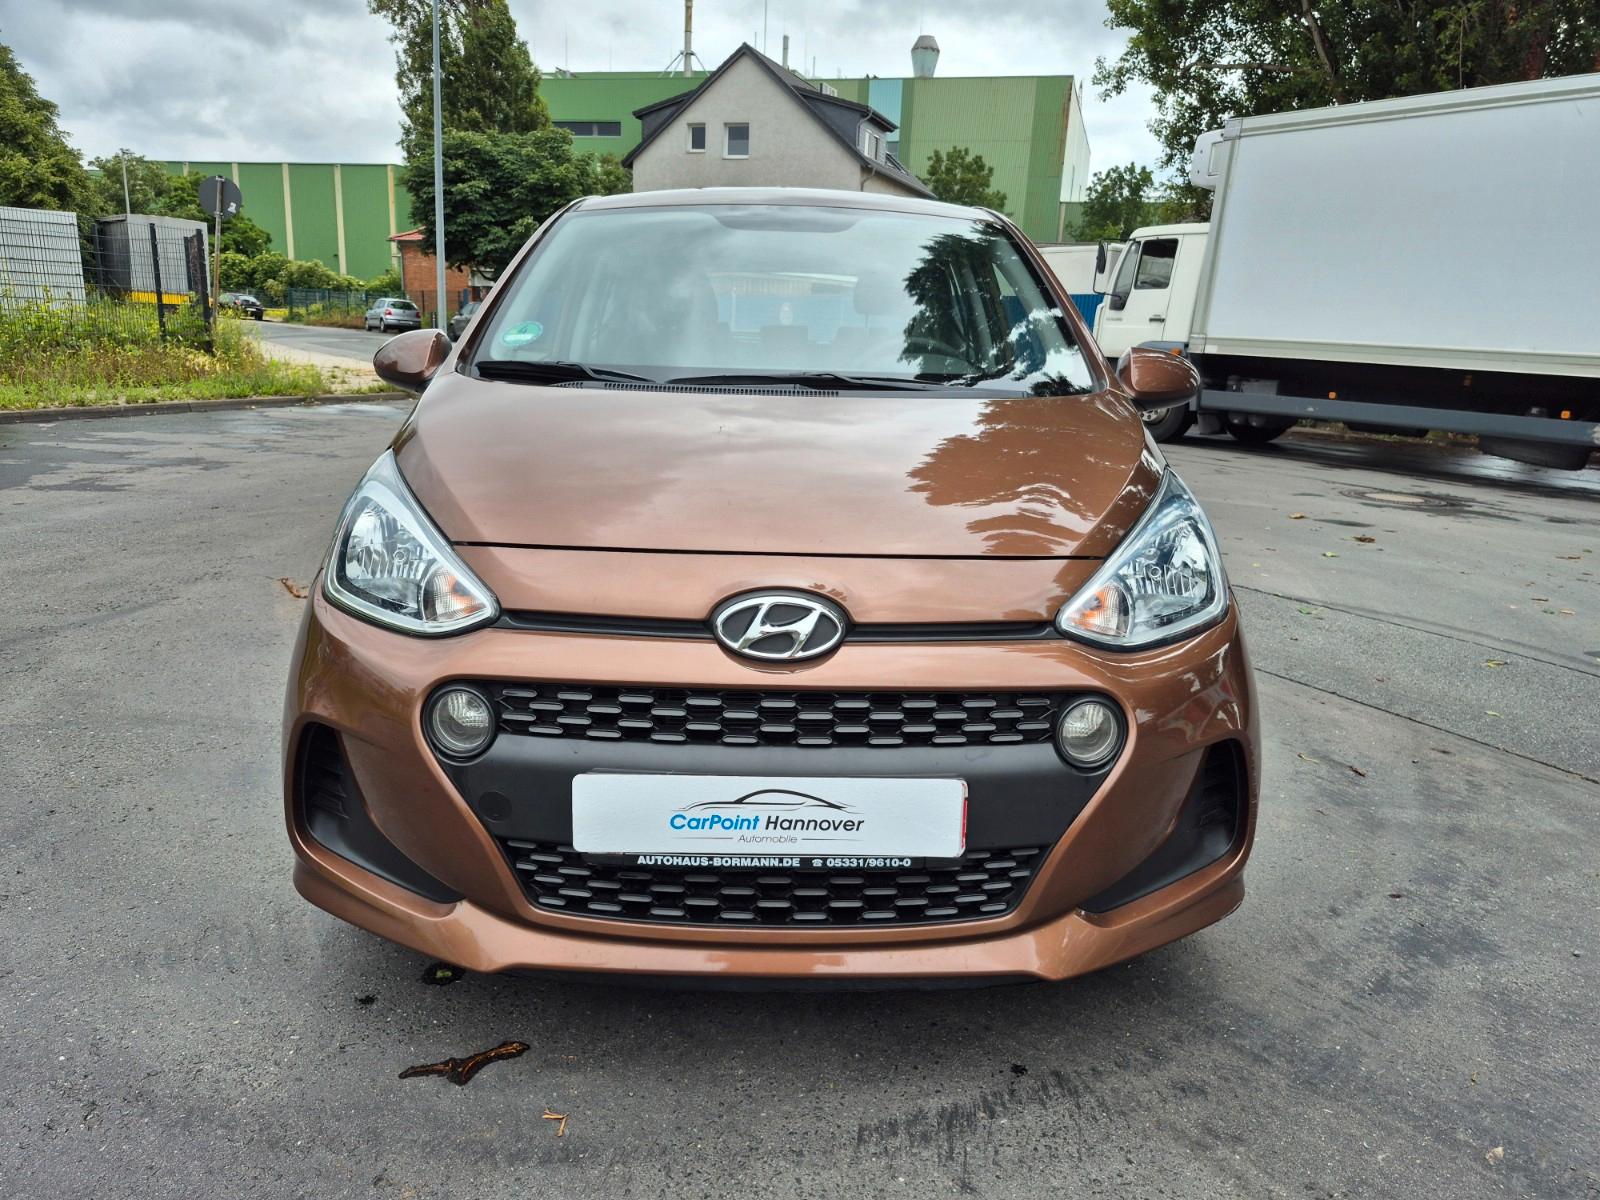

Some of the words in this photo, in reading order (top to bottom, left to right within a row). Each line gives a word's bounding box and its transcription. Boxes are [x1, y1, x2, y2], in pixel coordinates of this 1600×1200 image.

[669, 813, 760, 830] CarPoint
[765, 815, 864, 832] Hannover
[737, 834, 798, 844] Automobile
[637, 855, 800, 867] AUTOHAUS-BORMANN.DE
[826, 858, 912, 868] 05331/9610-0
